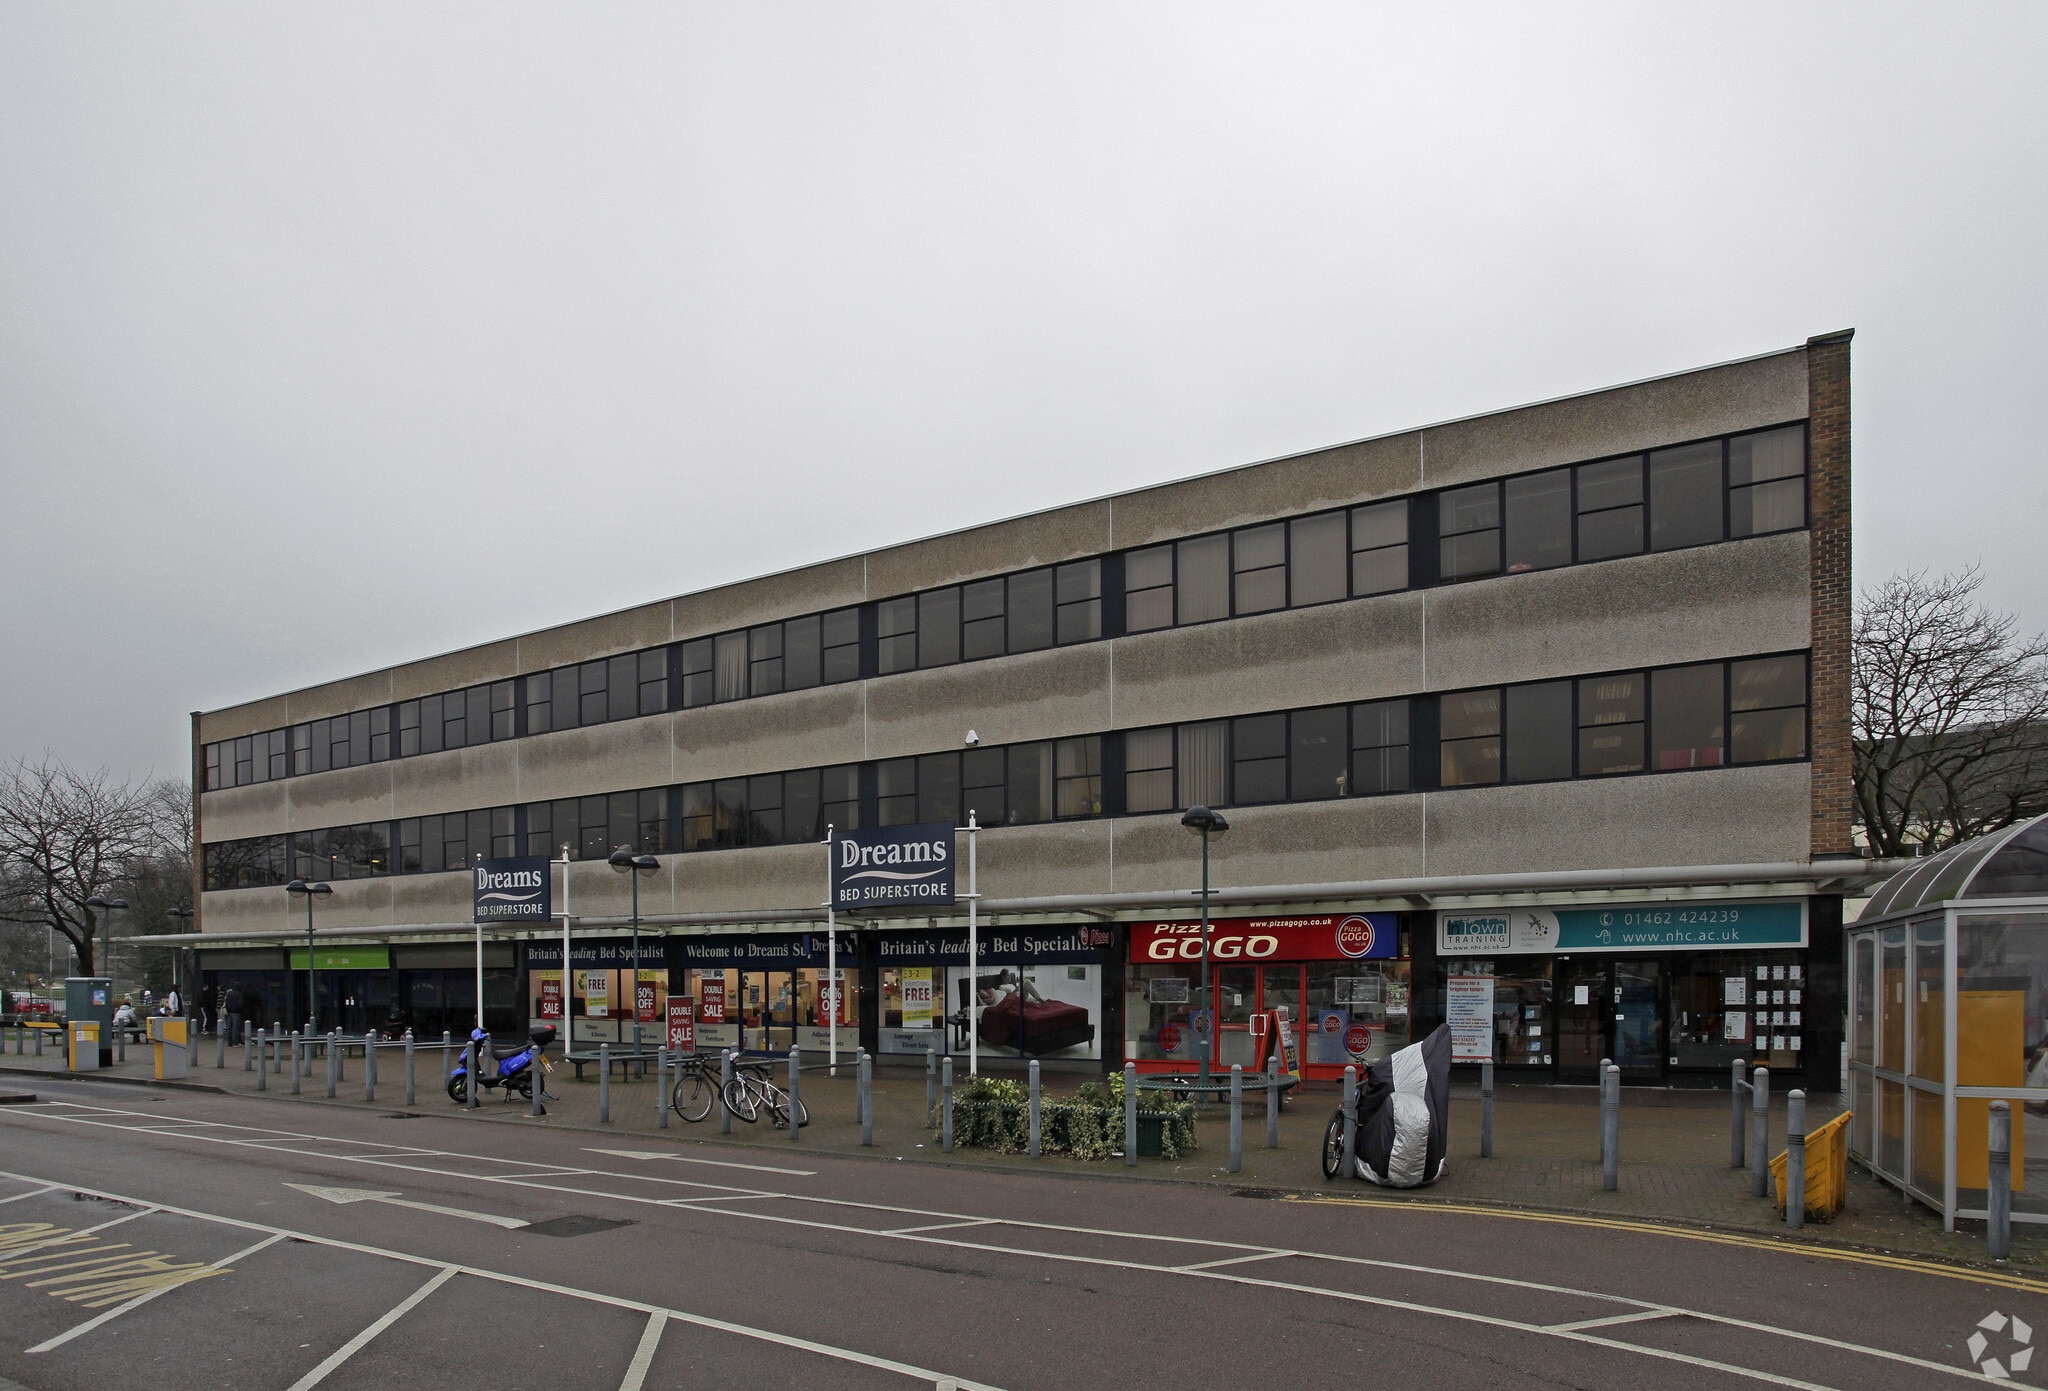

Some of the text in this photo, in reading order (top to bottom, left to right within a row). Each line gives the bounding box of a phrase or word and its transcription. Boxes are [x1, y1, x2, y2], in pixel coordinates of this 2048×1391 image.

[841, 840, 947, 868] Dreams
[477, 868, 542, 890] Dreams
[840, 883, 948, 902] BED SUPERSTORE
[477, 904, 543, 916] BED SUPERSTORE
[1249, 918, 1333, 928] www.pizzagogo.co.uk
[1624, 910, 1739, 925] 01462 424239
[1153, 923, 1216, 935] Pizza
[1622, 928, 1740, 942] www.nhc.ac.uk
[1340, 931, 1370, 942] GOGO
[1448, 935, 1505, 943] TRAINING
[686, 944, 730, 958] Welcome
[734, 945, 744, 957] to
[880, 940, 935, 956] Britain's
[940, 938, 987, 956] leadig
[993, 937, 1018, 953] Bed
[1147, 935, 1279, 960] GOGO
[528, 947, 564, 960] Britain's
[569, 947, 598, 961] eading
[600, 946, 616, 959] Bed
[543, 986, 559, 994] DOUBLE
[588, 979, 606, 990] FREE
[704, 985, 723, 994] DOUBLE
[638, 987, 654, 998] 60%
[905, 987, 930, 1001] FREE
[543, 1003, 559, 1015] SALE
[638, 999, 653, 1009] OFF
[822, 1000, 841, 1011] OF
[670, 1006, 692, 1016] DOUBLE
[704, 1004, 723, 1017] SALE
[672, 1018, 690, 1026] SAVING
[671, 1028, 692, 1042] SALE
